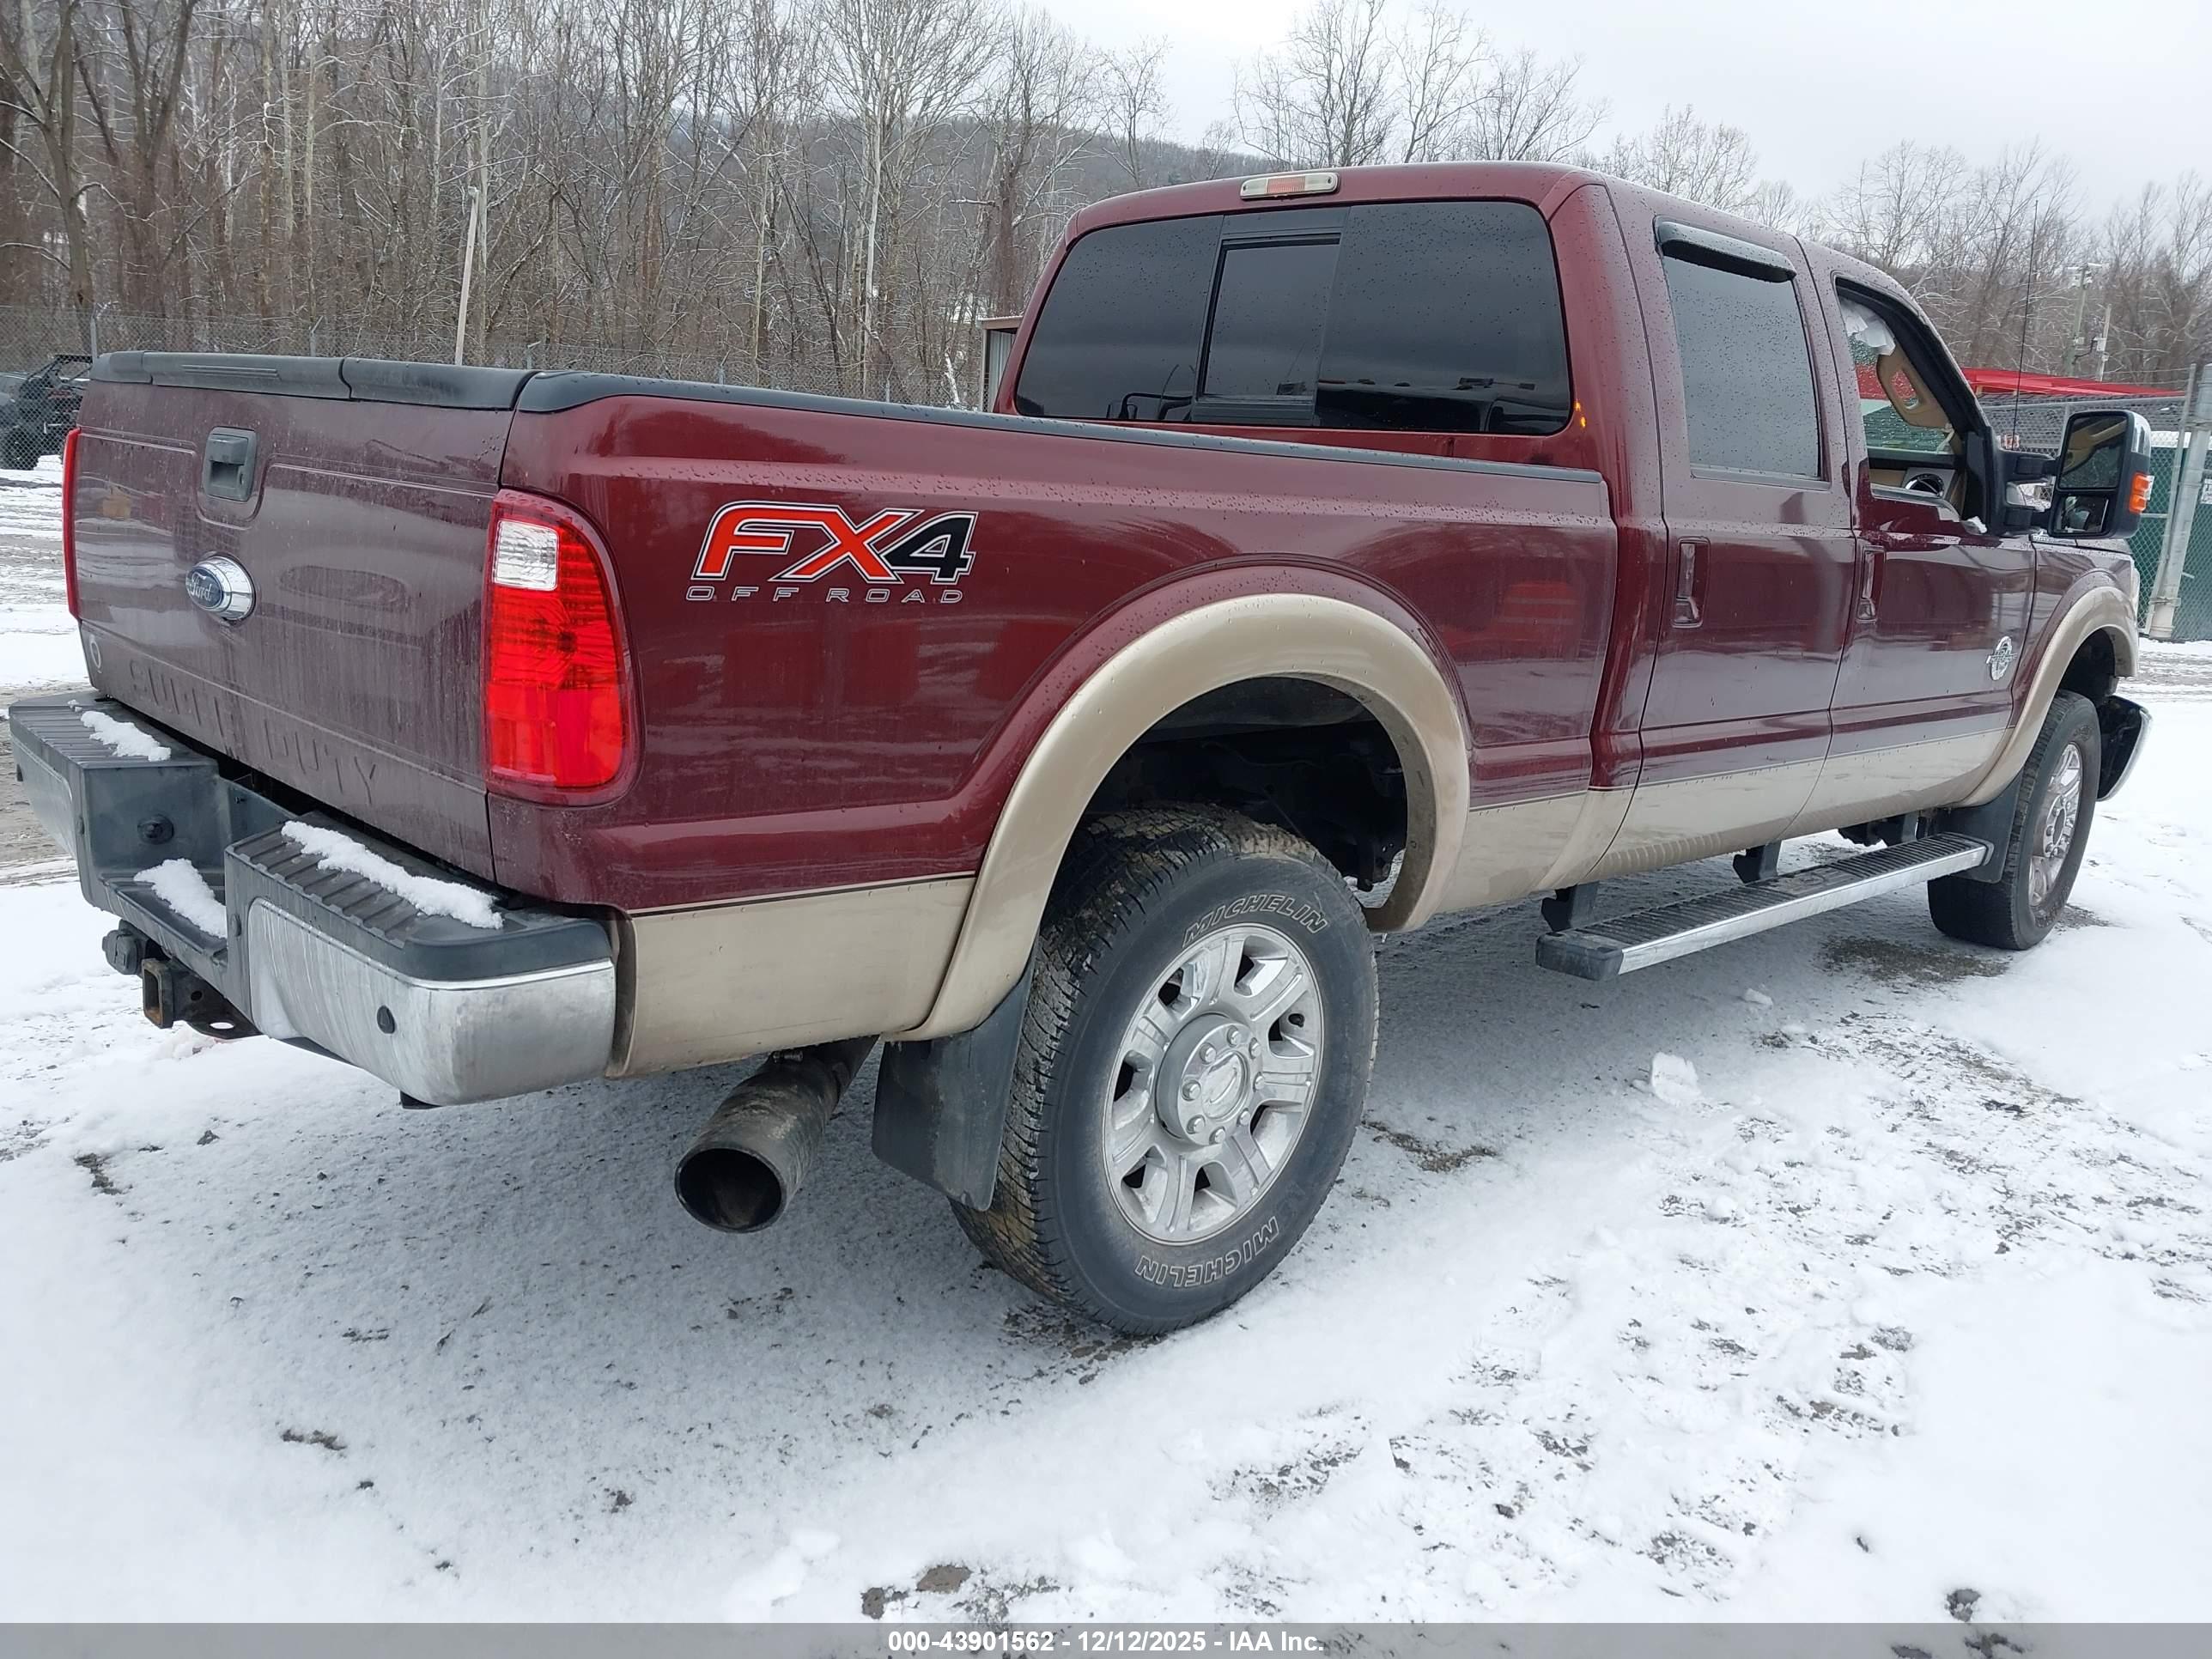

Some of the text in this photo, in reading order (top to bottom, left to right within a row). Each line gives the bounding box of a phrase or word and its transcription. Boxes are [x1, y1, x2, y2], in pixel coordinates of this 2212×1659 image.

[690, 500, 979, 586] FX4
[685, 586, 963, 604] OFF ROAD
[1182, 894, 1328, 949] MICHELIN
[1134, 1215, 1279, 1287] MICHELIN
